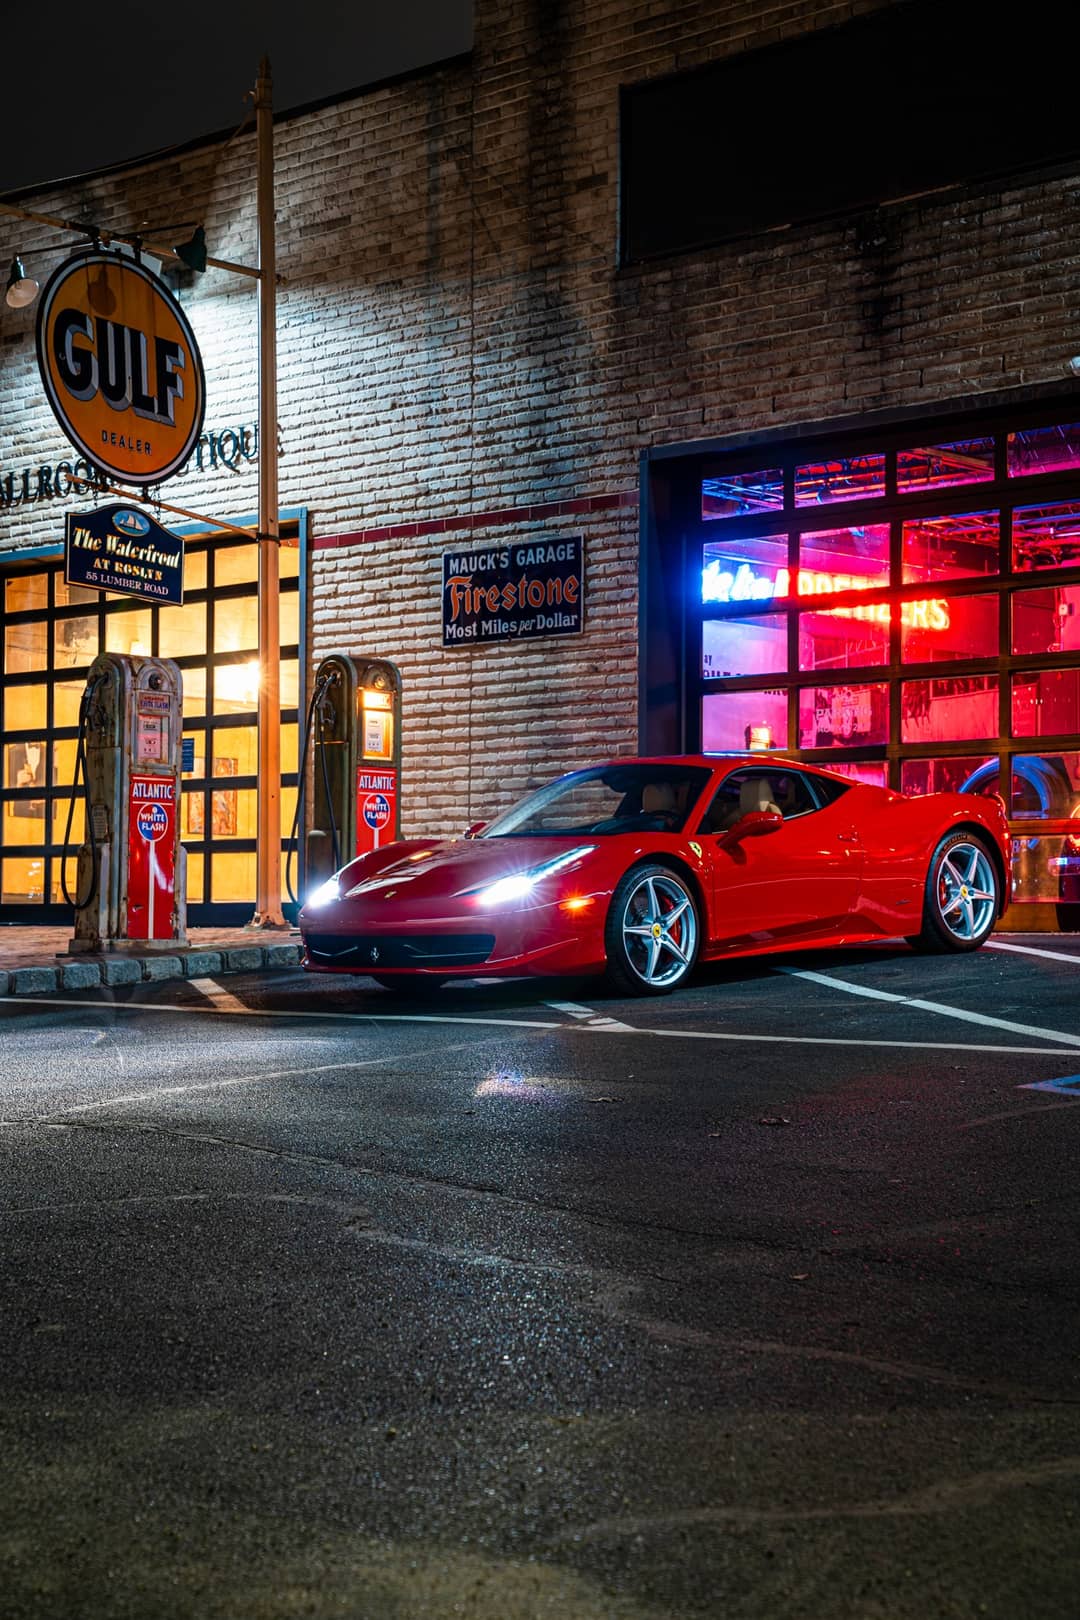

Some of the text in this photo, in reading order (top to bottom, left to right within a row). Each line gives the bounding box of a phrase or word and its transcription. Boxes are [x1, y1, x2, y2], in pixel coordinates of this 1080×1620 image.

[53, 308, 185, 427] GULF
[101, 430, 153, 456] DEALER
[72, 527, 180, 569] The Waterfront
[449, 543, 576, 576] MAUCK'S GARAGE
[93, 557, 164, 582] AT ROSLYN
[85, 571, 169, 596] 55 LUMBER ROAD
[445, 573, 579, 623] Firestone
[445, 612, 578, 640] Most Miles per Dollar
[132, 782, 173, 799] ATLANTIC
[359, 776, 395, 790] ATLANTIC
[140, 812, 165, 823] WHITE
[366, 803, 387, 812] WHITE
[366, 811, 387, 820] FLASH
[141, 821, 165, 832] FLASH
